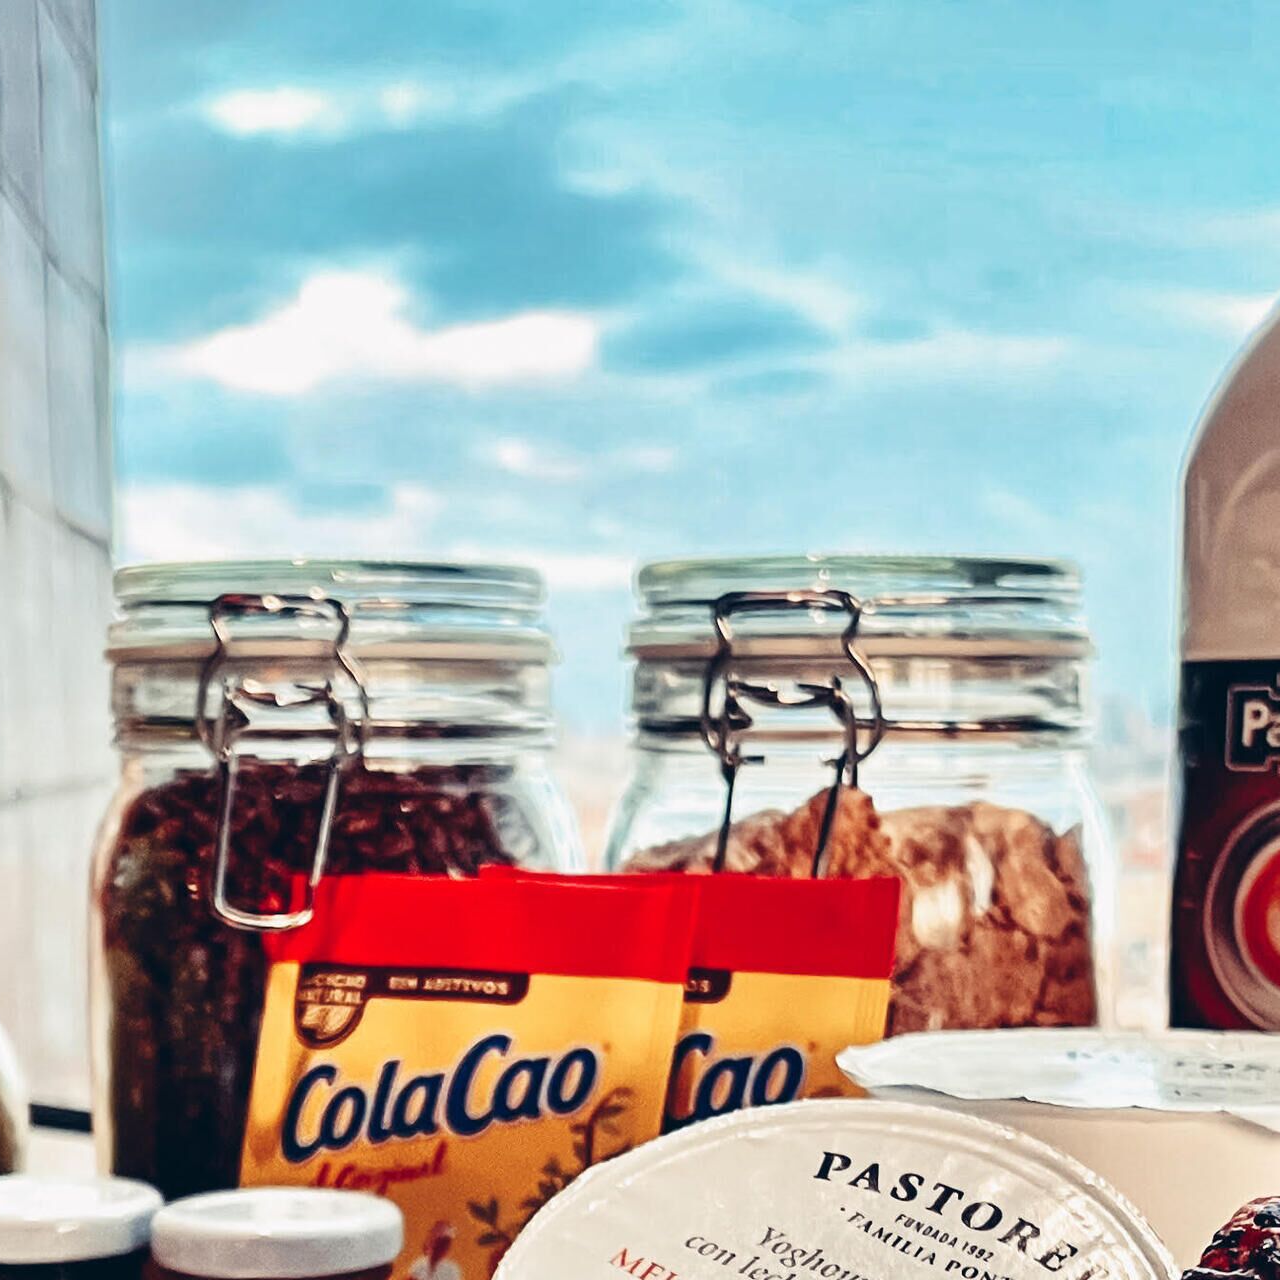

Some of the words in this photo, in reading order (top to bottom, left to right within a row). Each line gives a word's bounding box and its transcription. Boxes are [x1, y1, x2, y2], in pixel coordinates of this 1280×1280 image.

[281, 1033, 598, 1164] ColaCao
[684, 1235, 737, 1266] con
[895, 1213, 960, 1249] FUNDADA
[962, 1240, 995, 1264] 1992
